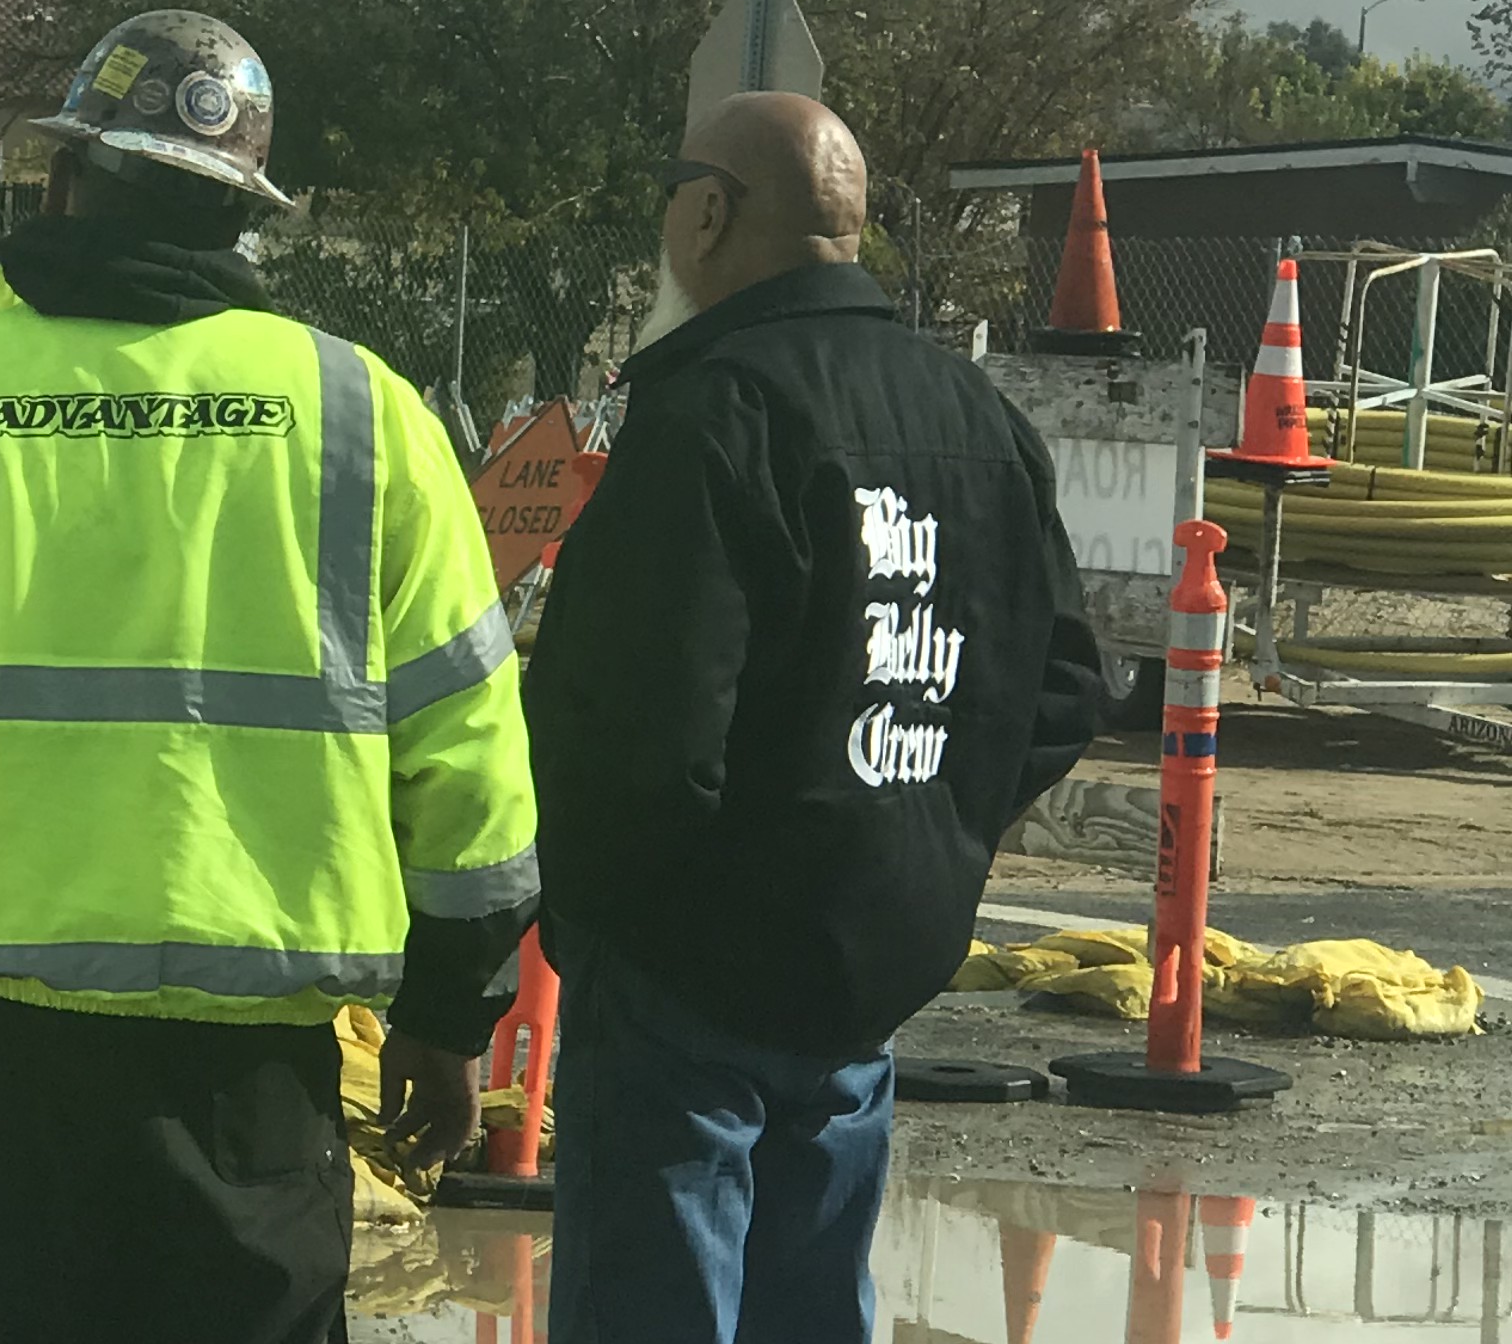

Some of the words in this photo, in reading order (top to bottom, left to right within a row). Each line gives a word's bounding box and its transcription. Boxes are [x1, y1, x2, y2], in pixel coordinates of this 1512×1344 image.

[498, 459, 566, 488] LANE
[854, 486, 939, 597] Big
[863, 602, 965, 704] Belly
[848, 702, 948, 788] Crew
[1448, 714, 1512, 747] ARIZON
